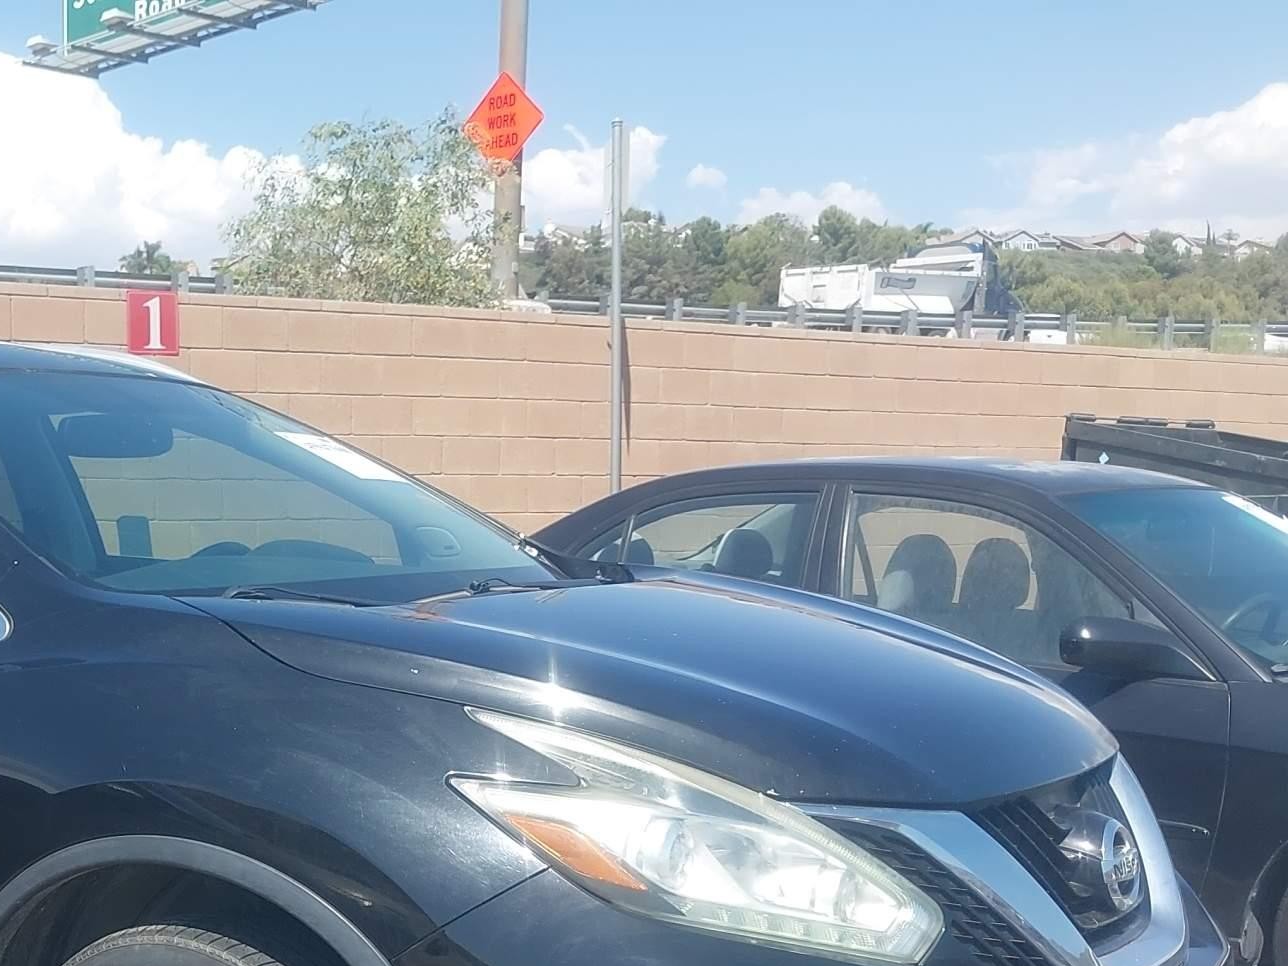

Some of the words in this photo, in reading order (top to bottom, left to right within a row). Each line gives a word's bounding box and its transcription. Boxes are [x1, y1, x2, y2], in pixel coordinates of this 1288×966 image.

[489, 93, 516, 111] ROAD
[488, 112, 517, 131] WORK
[487, 132, 518, 149] HEAD
[142, 295, 167, 350] 1
